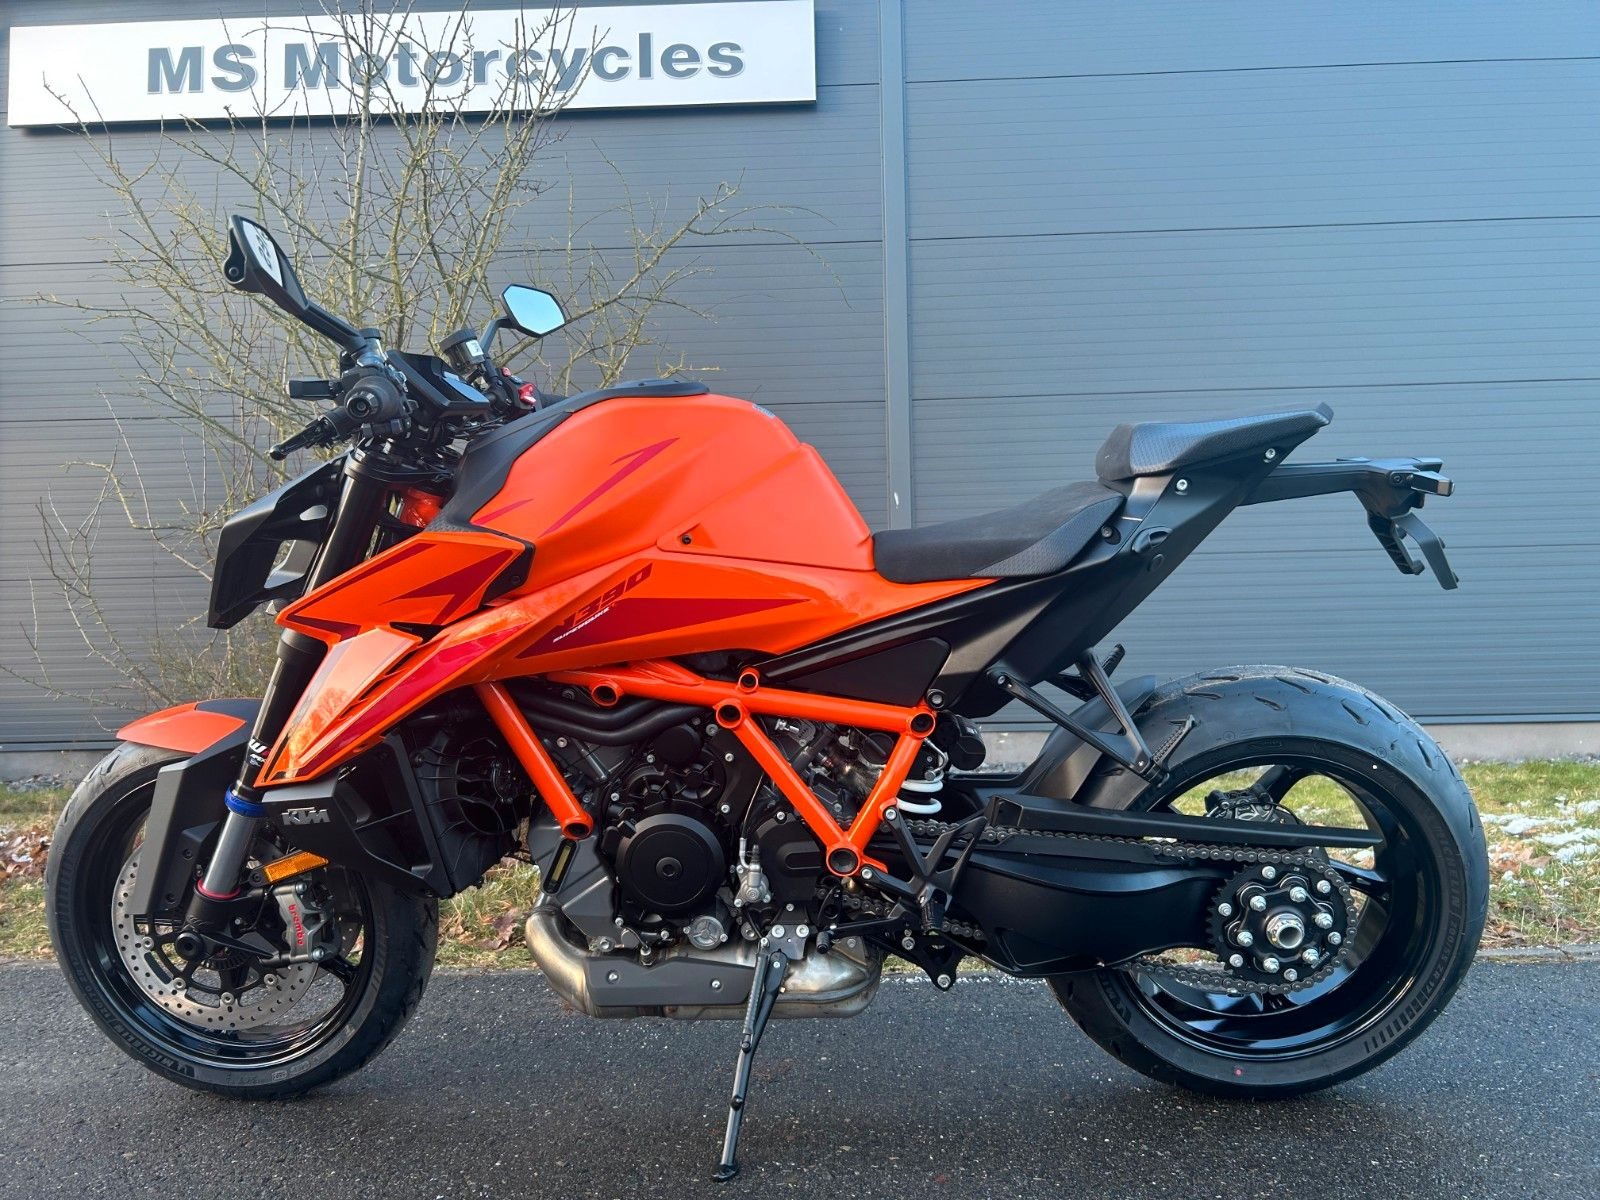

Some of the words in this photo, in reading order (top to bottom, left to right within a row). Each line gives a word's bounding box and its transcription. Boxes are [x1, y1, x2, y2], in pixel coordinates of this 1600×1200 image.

[147, 43, 257, 94] MS
[283, 32, 745, 93] Motorcycles
[281, 806, 331, 826] KTM
[287, 903, 305, 947] brembo
[113, 1022, 175, 1068] MICHELIN
